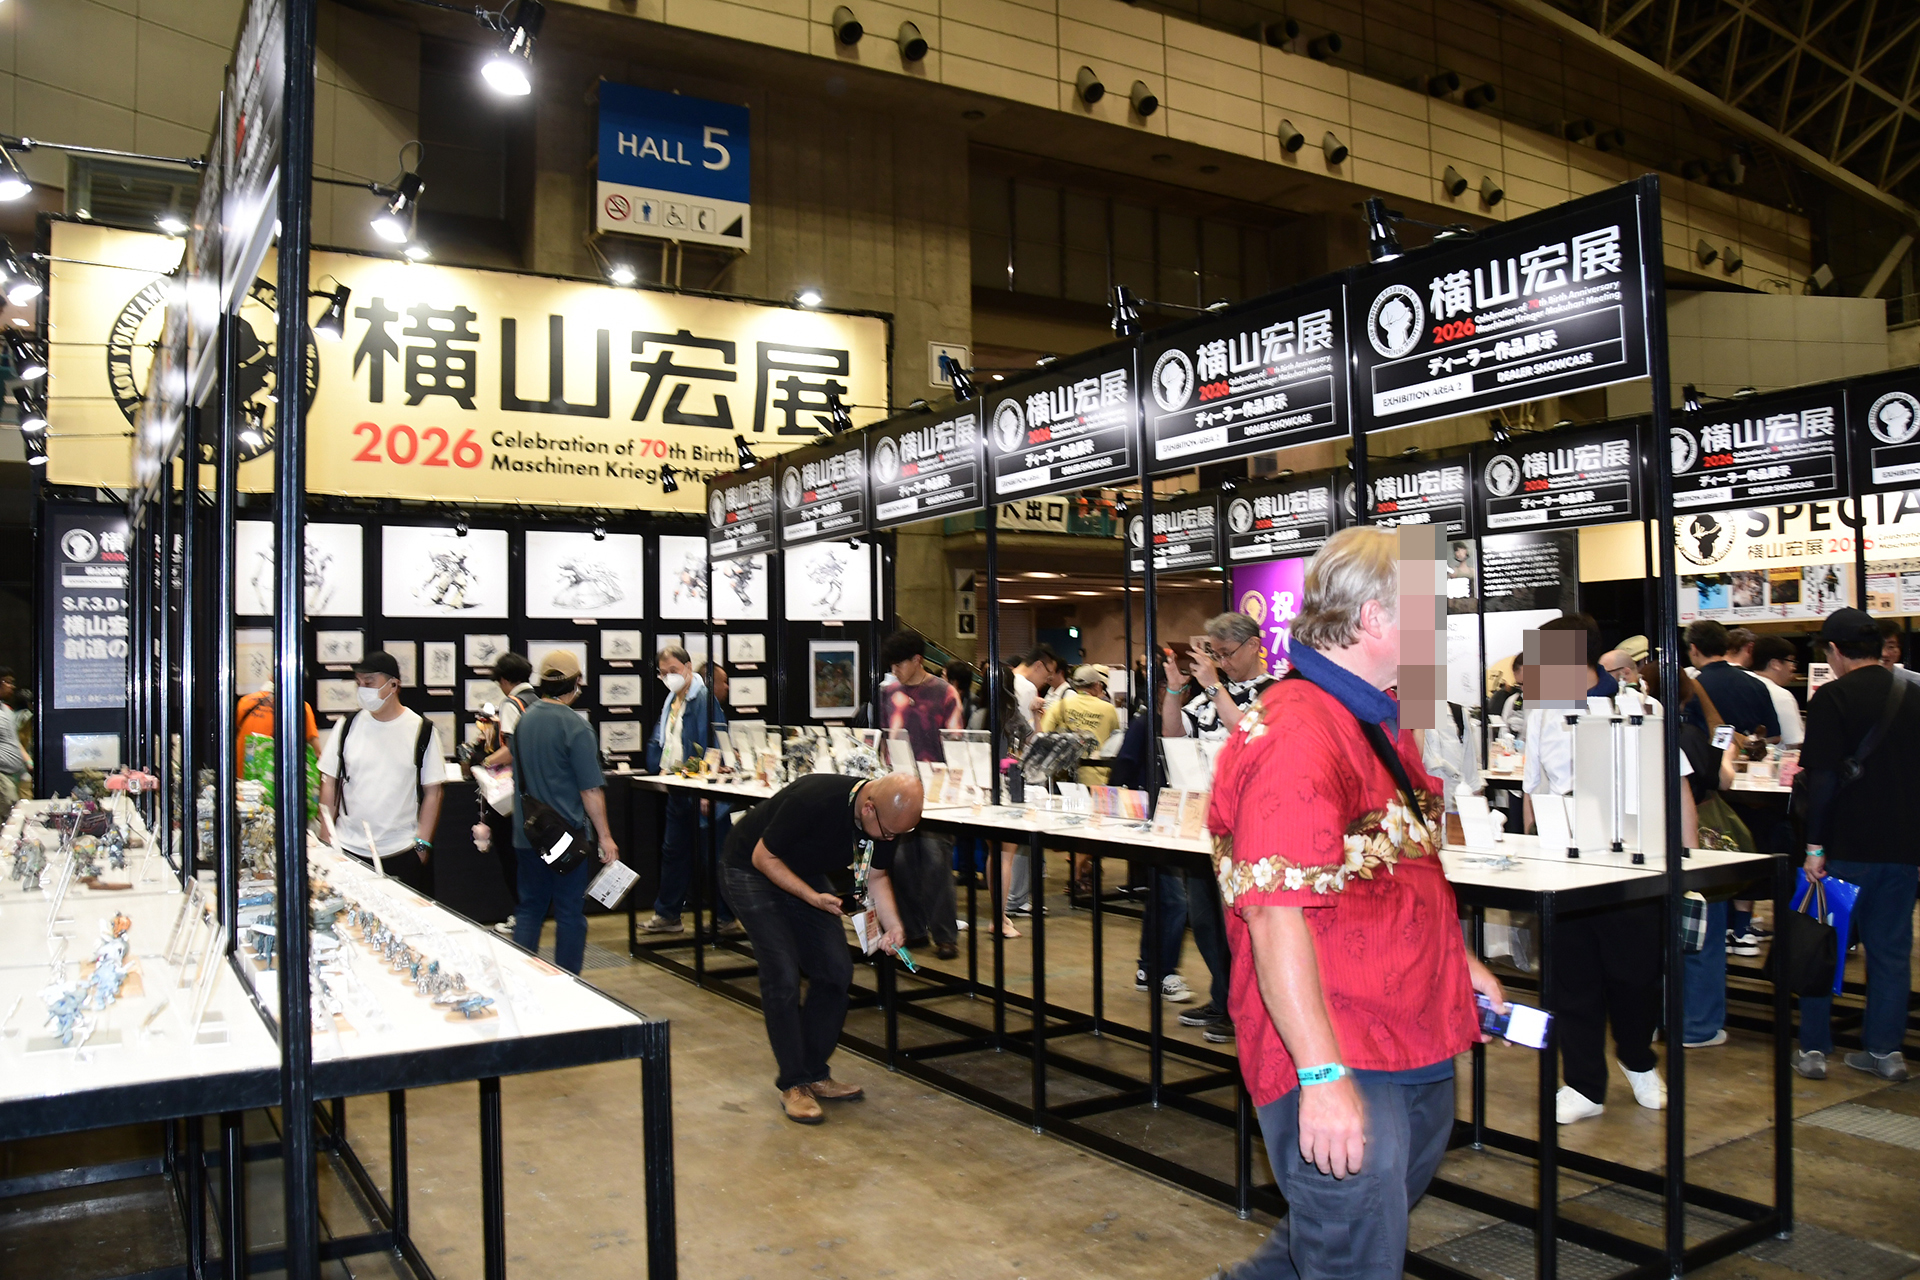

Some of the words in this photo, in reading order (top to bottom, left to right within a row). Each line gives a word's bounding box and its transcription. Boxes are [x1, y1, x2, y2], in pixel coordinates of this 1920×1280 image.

[618, 131, 692, 166] HALL
[702, 125, 731, 171] 5
[1429, 224, 1622, 321] 横山宏展
[1569, 281, 1621, 299] Anniversary
[1586, 291, 1622, 306] Meeting
[1197, 309, 1334, 382] 横山宏展
[1432, 318, 1475, 344] 2026
[353, 296, 850, 436] 横山宏展
[1428, 329, 1558, 376] ディーラー作品展示
[1497, 363, 1534, 383] DEALER
[1534, 352, 1594, 377] SHOWCASE
[1026, 368, 1128, 428] 横山宏展
[1198, 380, 1230, 401] 2026
[1382, 389, 1430, 407] EXHIBITION
[1431, 384, 1454, 397] AREA
[352, 421, 484, 468] 2026
[491, 430, 609, 455] Celebration
[615, 439, 634, 456] of
[640, 438, 687, 460] 70th
[692, 445, 735, 464] Birth
[1700, 406, 1835, 454] 横山宏展
[491, 454, 600, 477] Maschinen
[1522, 439, 1630, 478] 横山宏展
[1703, 453, 1734, 467] 2026
[1374, 465, 1464, 501] 横山宏展
[1748, 539, 1823, 559] 横山宏展
[1270, 590, 1296, 622] 祝
